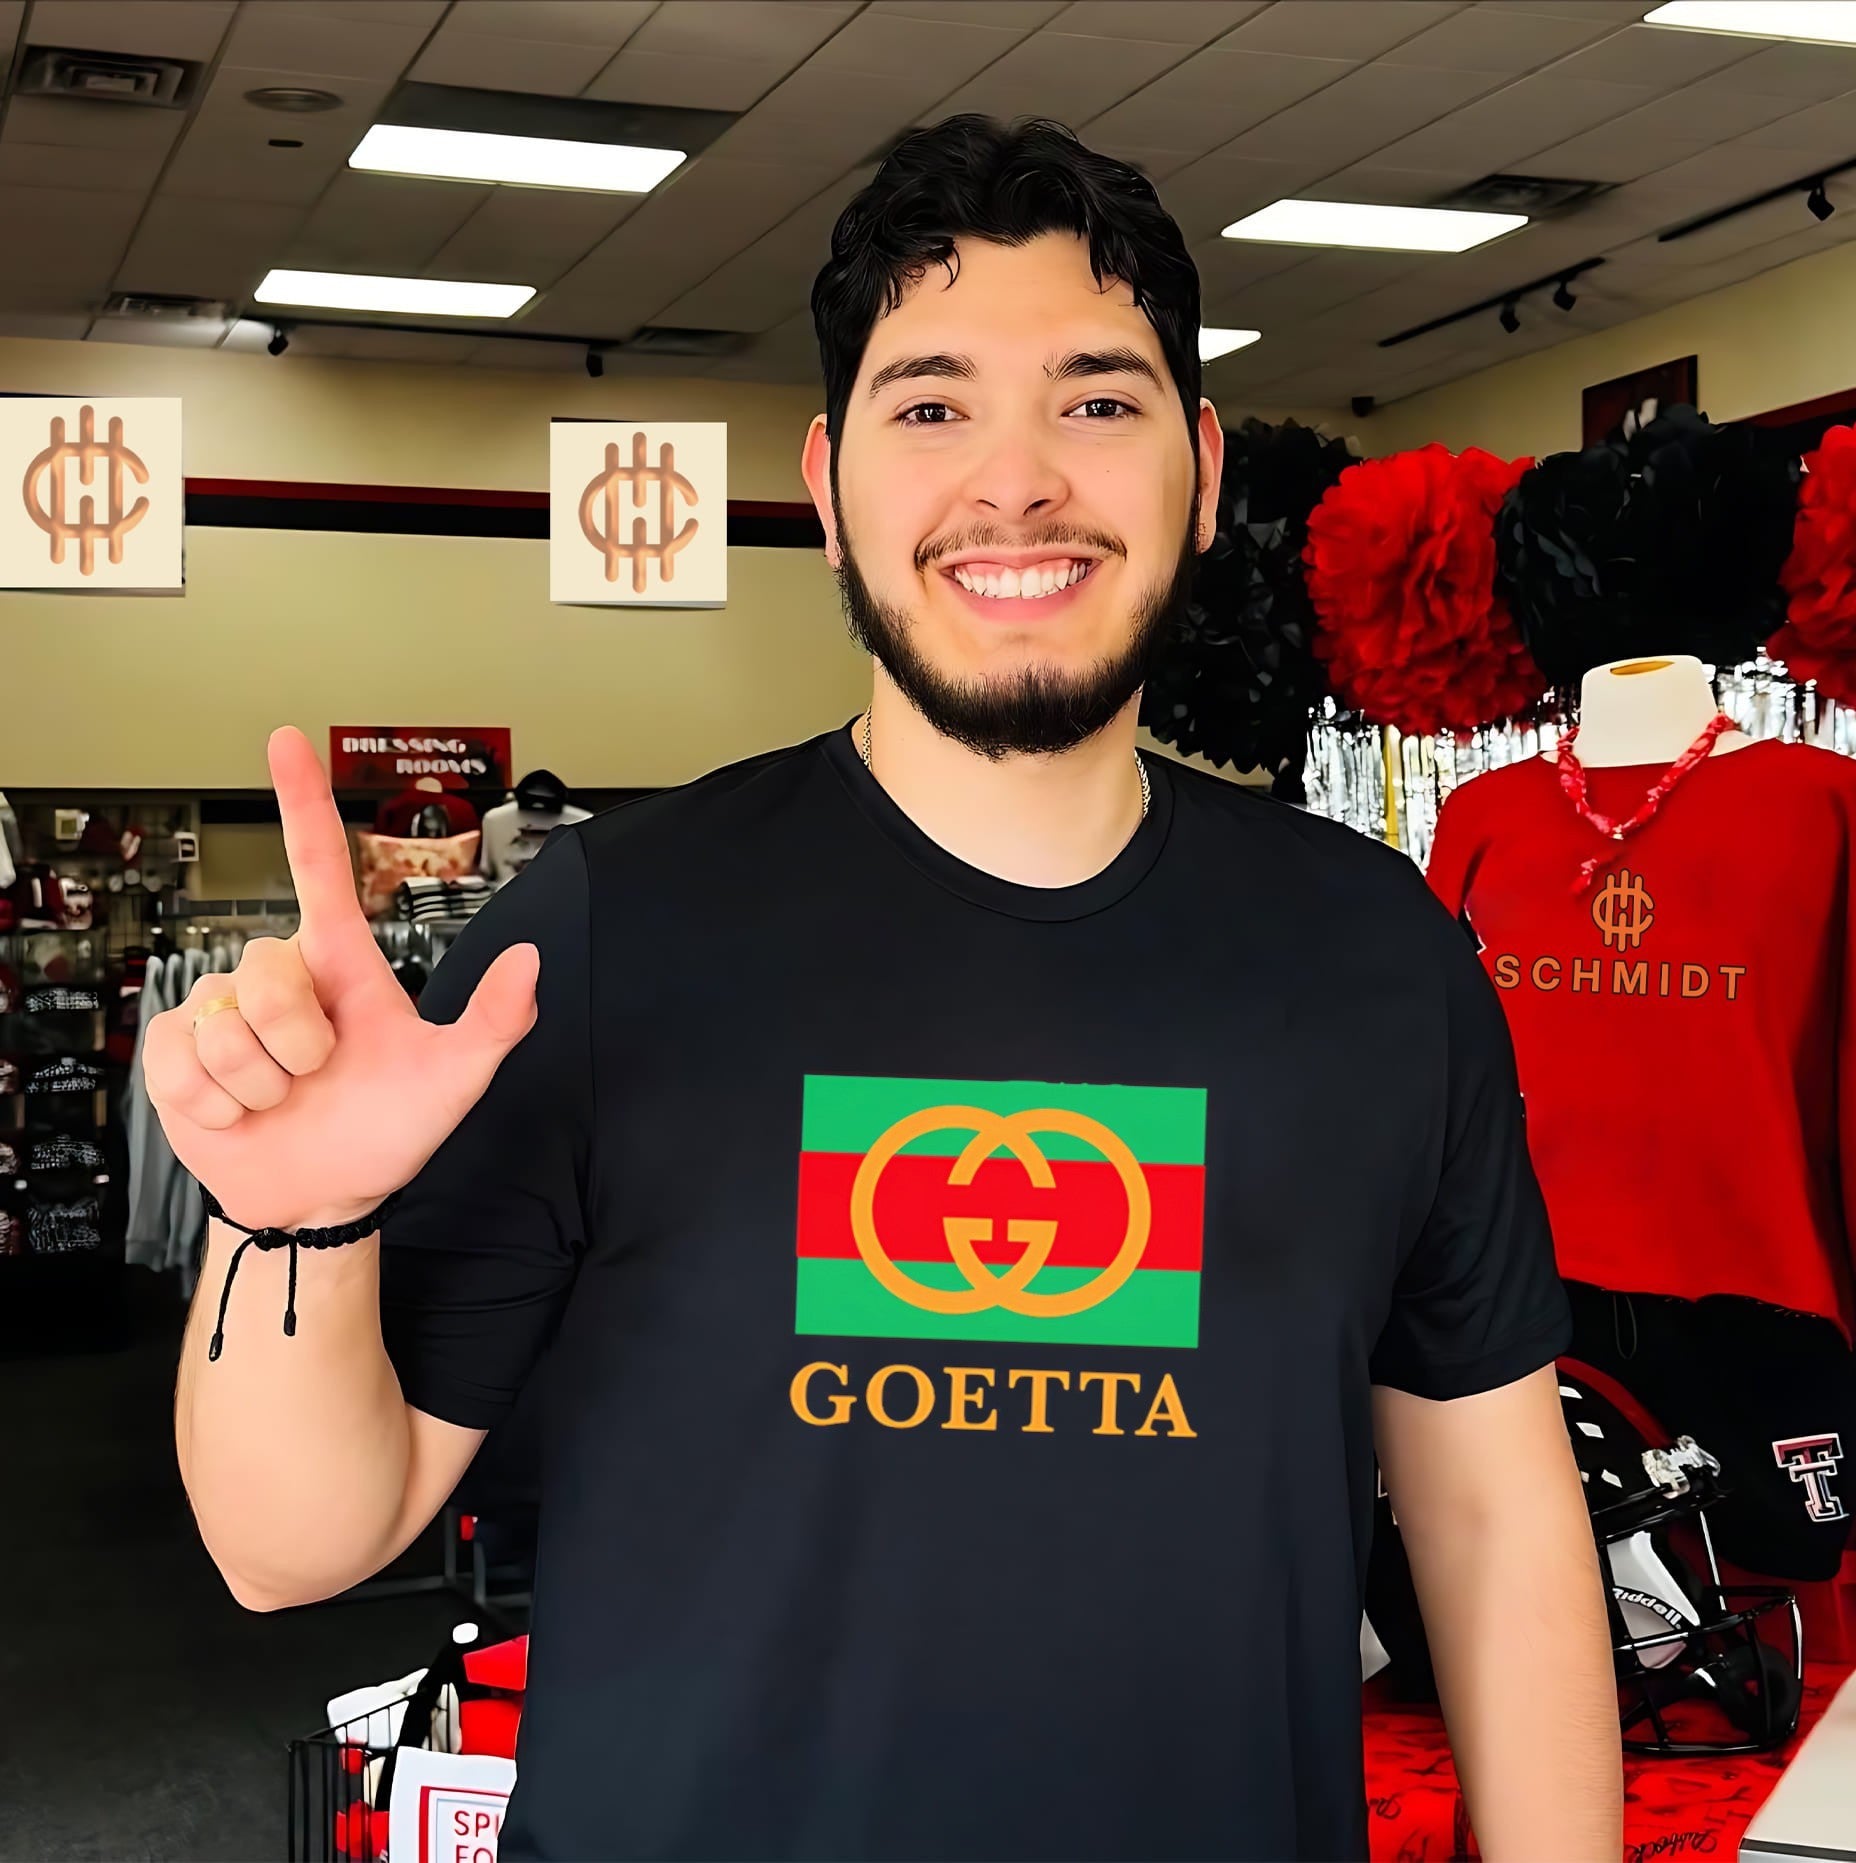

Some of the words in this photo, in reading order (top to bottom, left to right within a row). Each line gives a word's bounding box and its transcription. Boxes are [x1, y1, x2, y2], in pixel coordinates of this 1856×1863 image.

[342, 737, 467, 754] DRESSING
[396, 758, 487, 775] ROOMS
[1493, 953, 1747, 1000] SCHMIDT
[789, 1360, 1198, 1438] GOETTA
